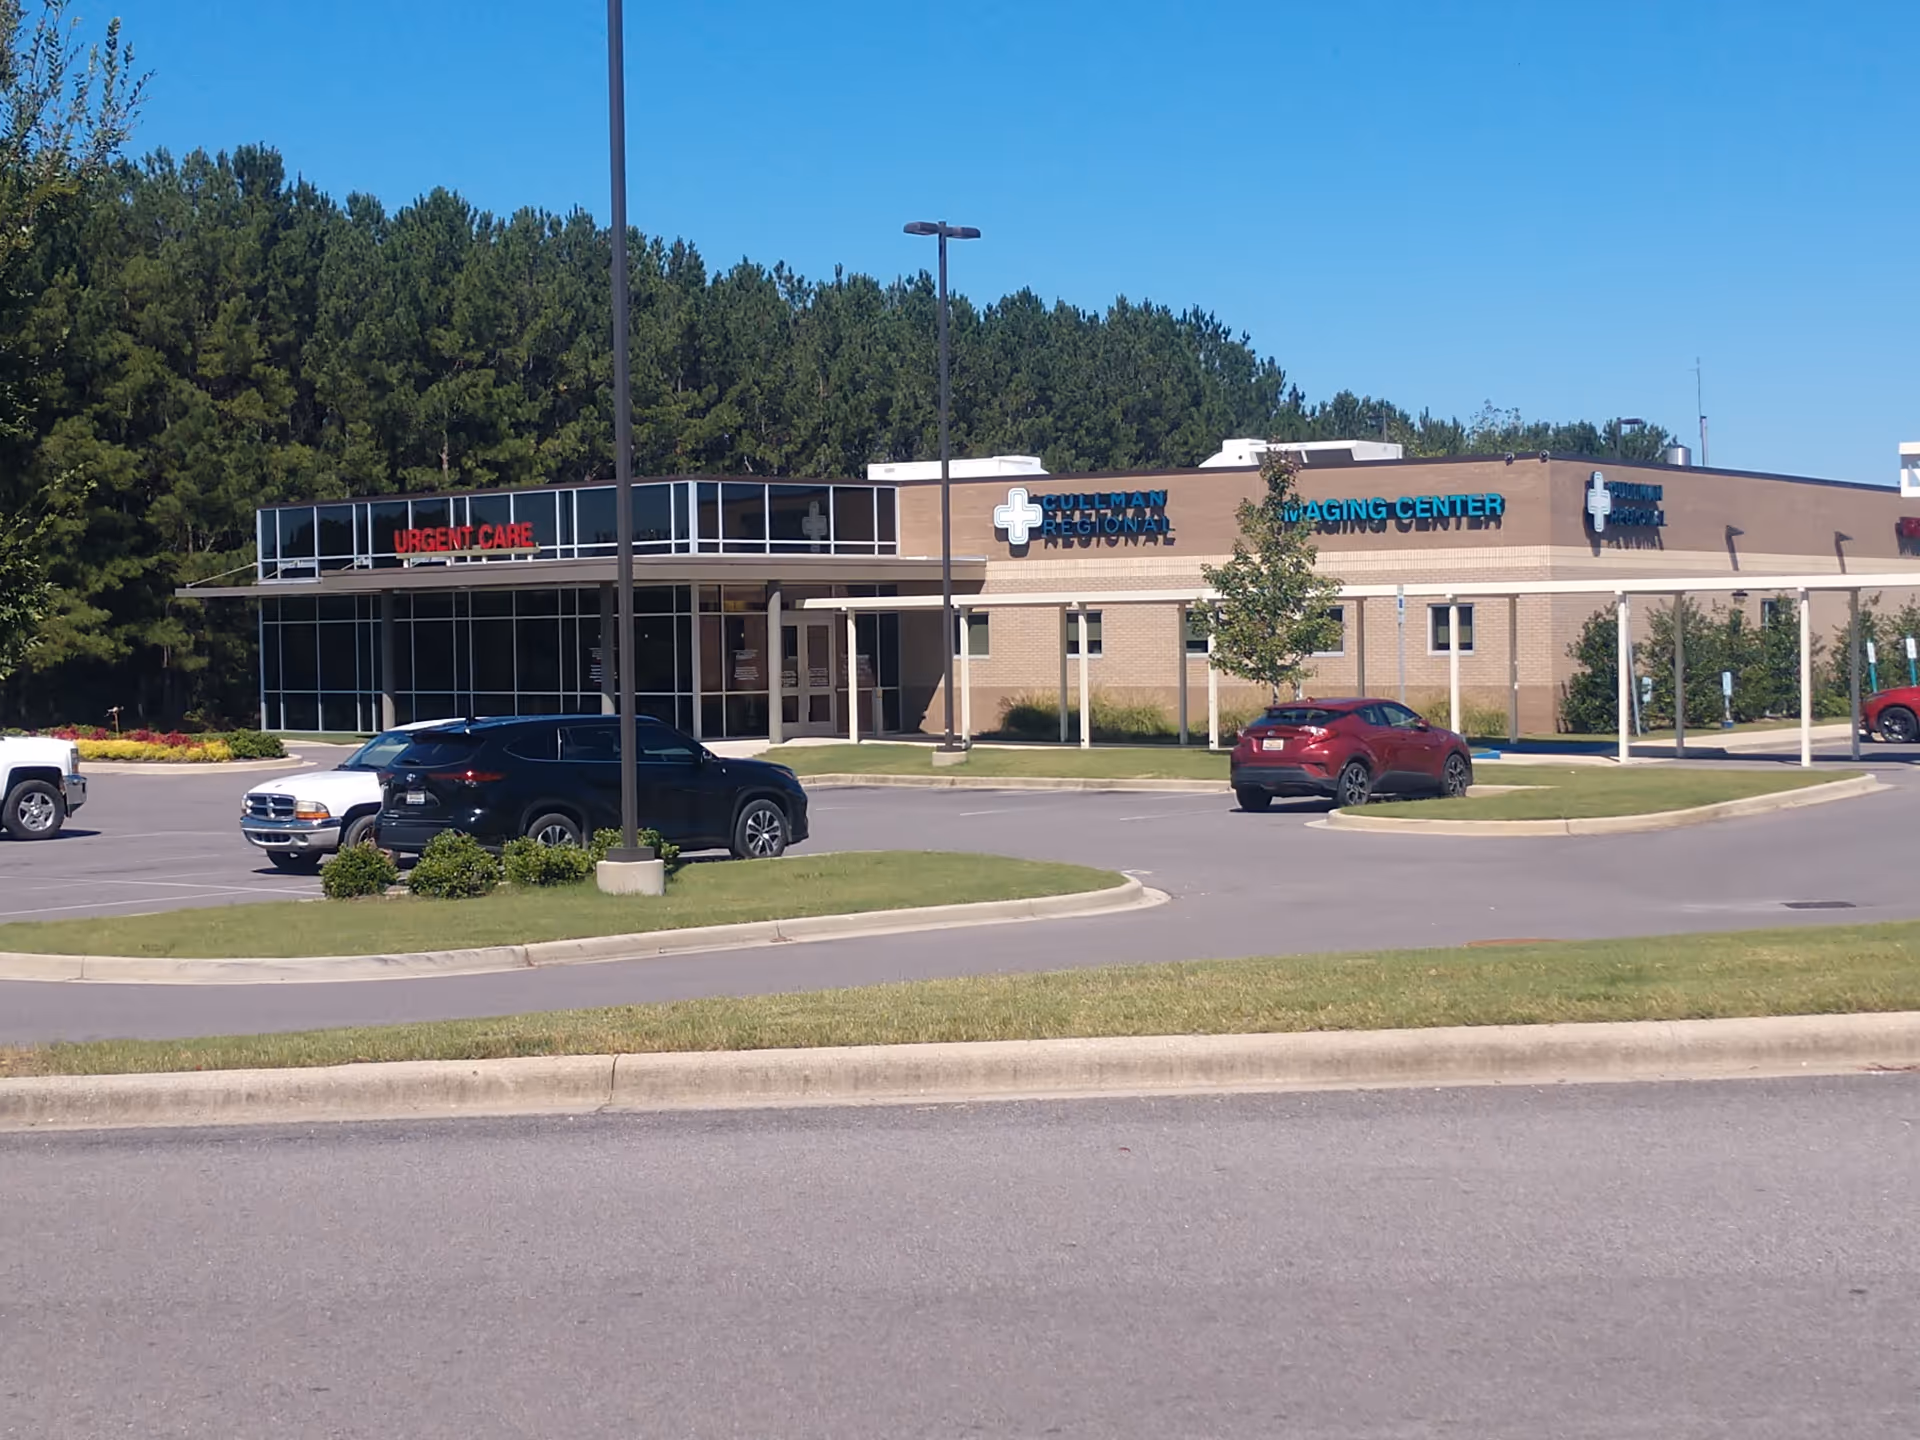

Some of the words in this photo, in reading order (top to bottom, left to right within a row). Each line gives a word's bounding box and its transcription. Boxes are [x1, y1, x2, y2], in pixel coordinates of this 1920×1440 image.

[1043, 490, 1165, 510] CULLMAN
[1279, 496, 1387, 522] MAGING
[1395, 493, 1504, 519] CENTER
[394, 526, 473, 553] URGENT
[479, 522, 534, 549] CARE
[1043, 515, 1172, 536] REGIONAL
